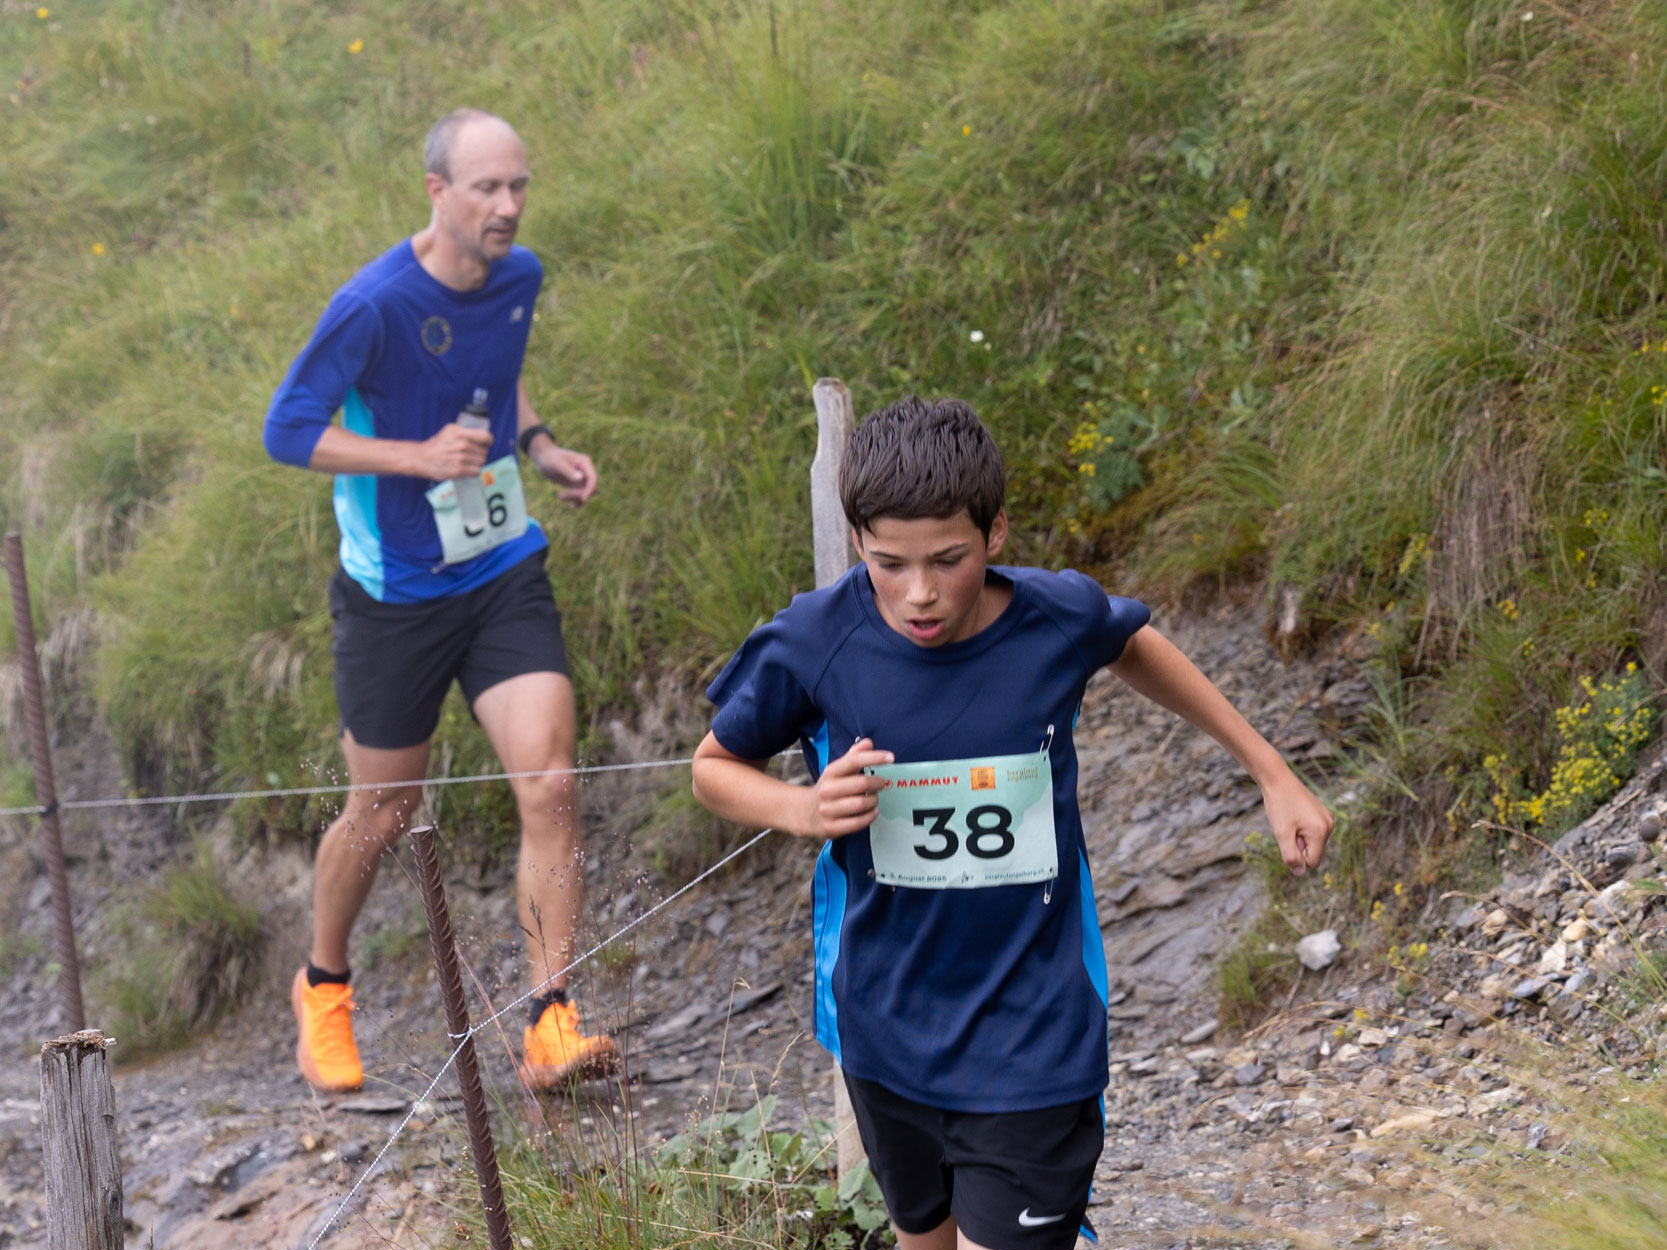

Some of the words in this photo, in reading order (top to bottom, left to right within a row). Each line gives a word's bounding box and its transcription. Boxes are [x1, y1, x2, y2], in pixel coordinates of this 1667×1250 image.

[464, 492, 508, 538] 6
[896, 775, 959, 789] MAMMUT
[912, 804, 1015, 860] 38
